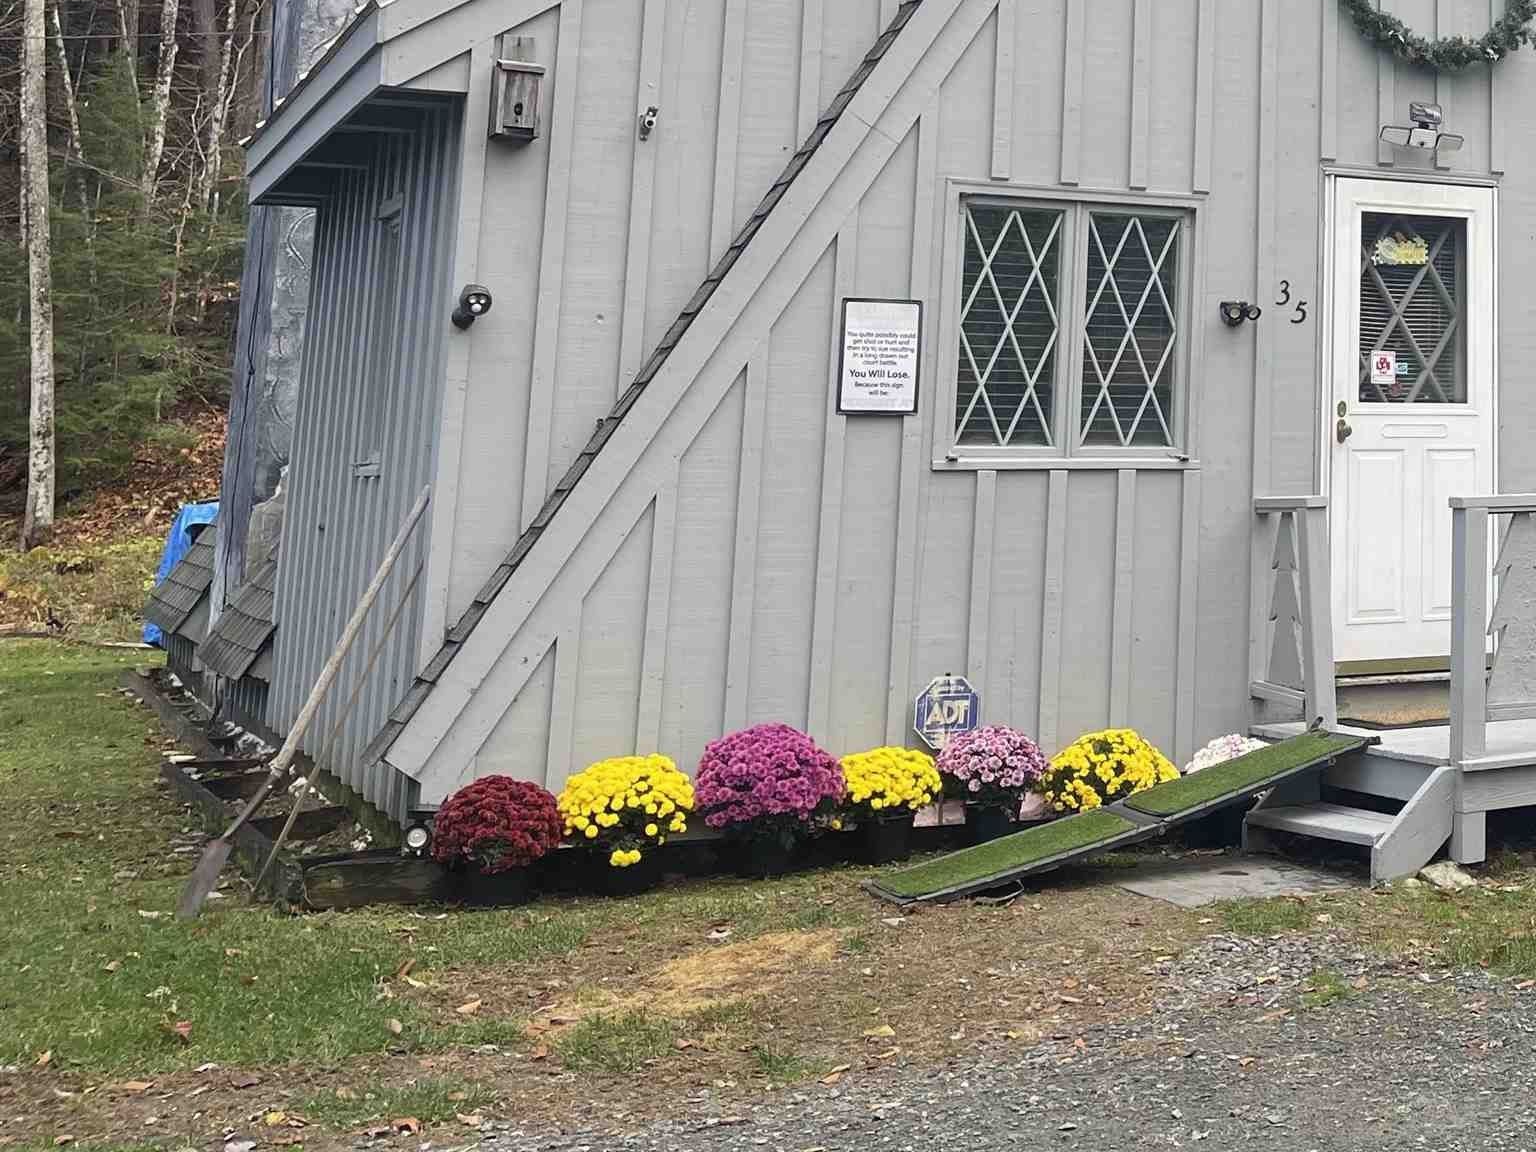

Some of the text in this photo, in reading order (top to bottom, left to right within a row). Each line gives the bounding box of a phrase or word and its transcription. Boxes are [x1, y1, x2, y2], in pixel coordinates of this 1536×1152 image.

[1275, 280, 1307, 324] 35
[849, 368, 911, 379] You Will Lose.
[925, 699, 970, 726] ADT
